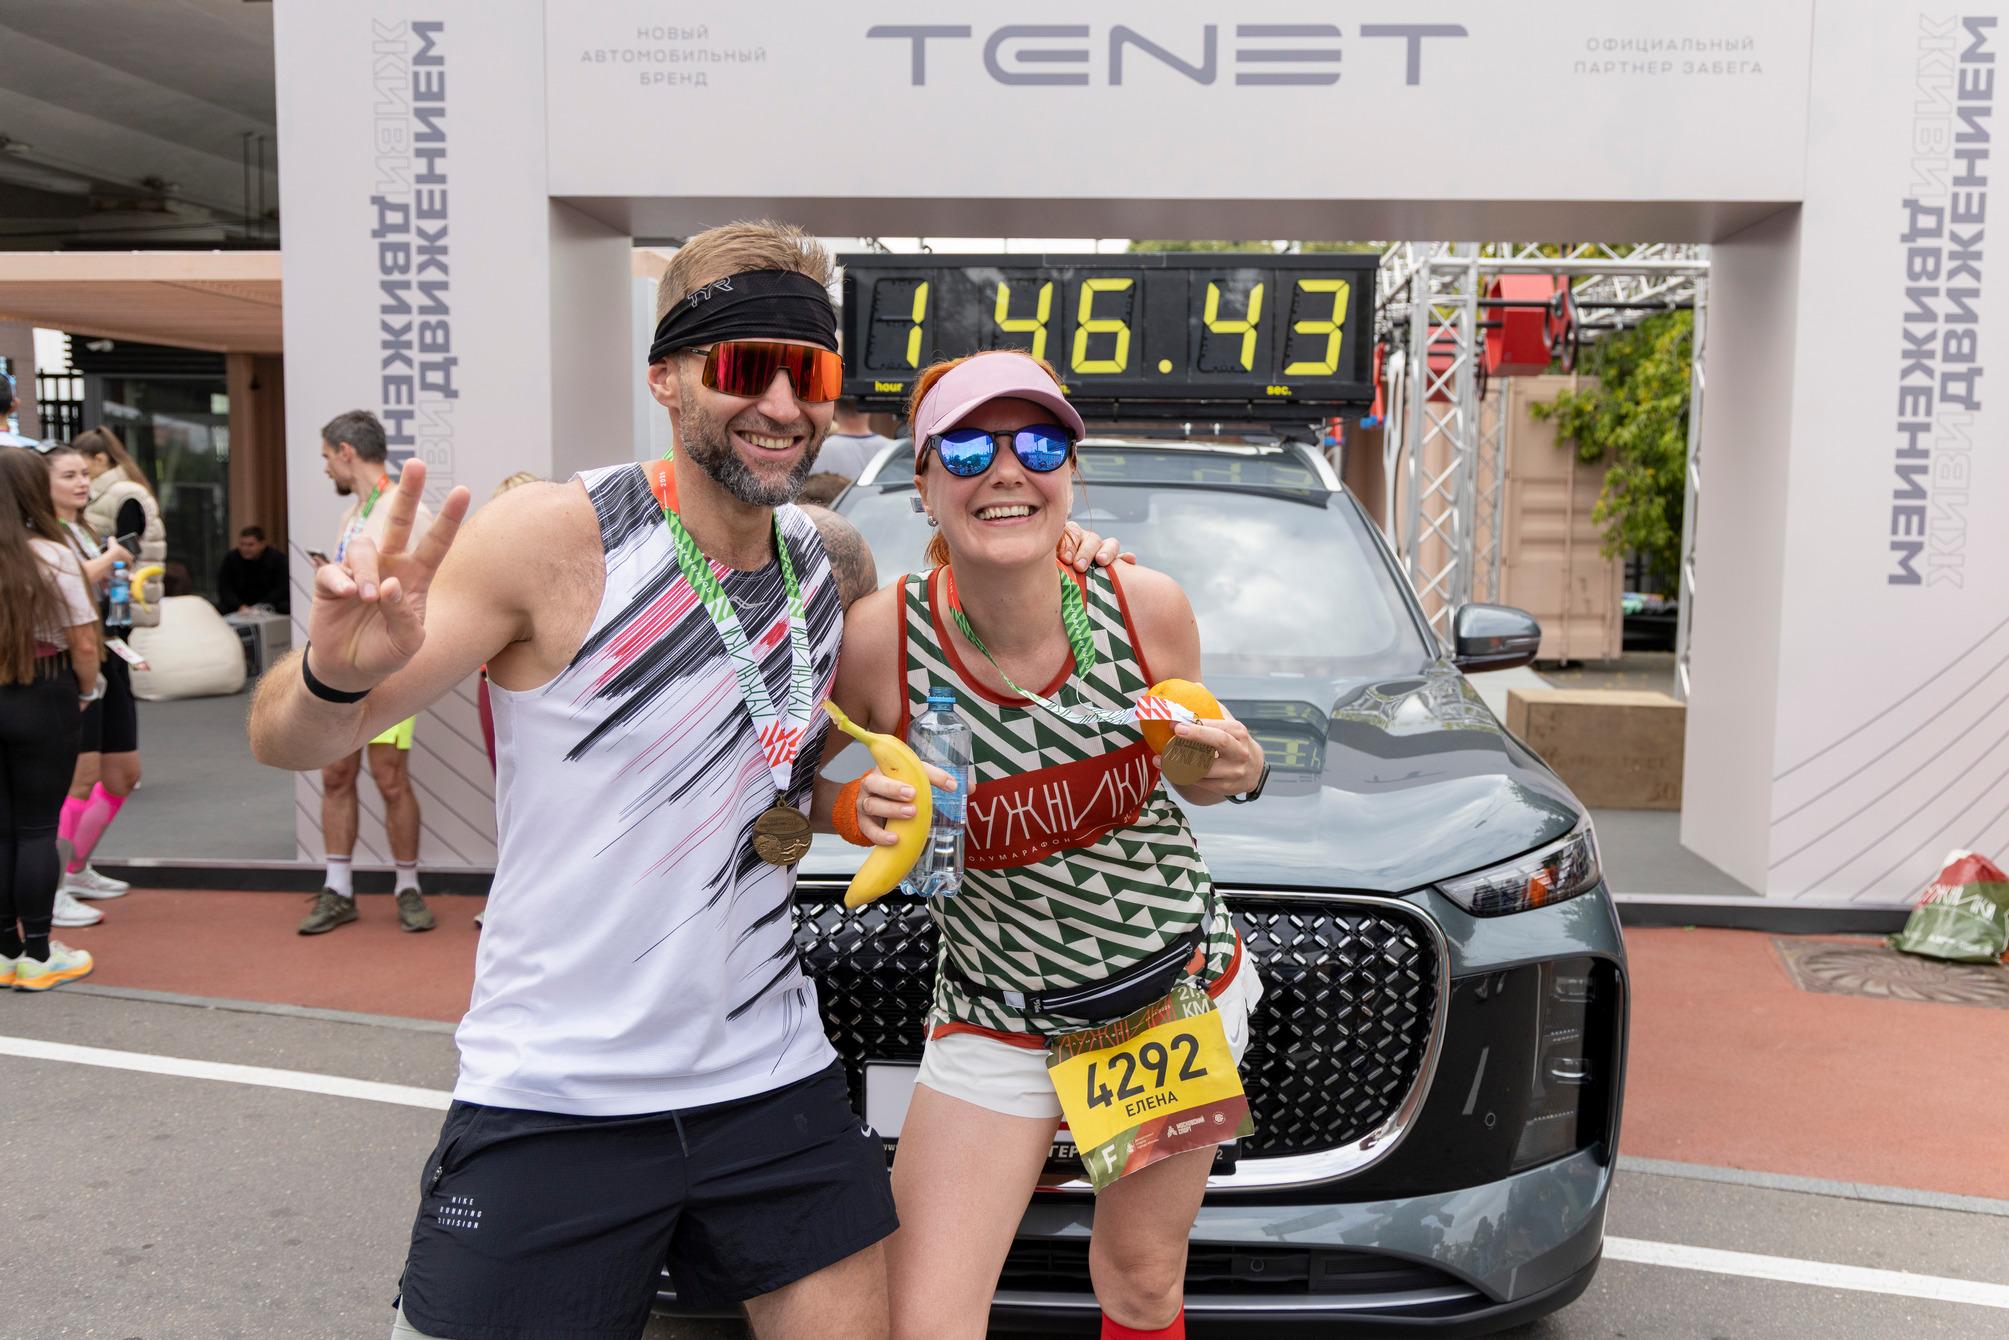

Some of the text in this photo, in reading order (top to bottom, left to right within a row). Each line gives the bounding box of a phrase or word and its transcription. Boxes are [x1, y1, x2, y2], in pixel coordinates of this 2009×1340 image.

[637, 24, 710, 40] НОВЫЙ
[1586, 36, 1755, 52] ОФИЦИАЛЬНЫЙ
[580, 47, 767, 63] АВТОМОБИЛЬНЫЙ
[866, 24, 1468, 86] TENET
[1574, 60, 1763, 74] ПАРТНЕР ЗАБЕГА
[640, 71, 709, 87] БРЕНД
[411, 21, 459, 399] ДВИЖЕНИЕМ
[1939, 16, 1998, 411] ДВИЖЕНИЕМ
[687, 276, 733, 308] TYR
[370, 195, 415, 485] ДВИЖЕНИ
[875, 381, 903, 392] hour
[1266, 385, 1293, 396] sec.
[1888, 198, 1945, 586] ДВИЖЕНИЕМ
[967, 838, 1071, 862] ОЛУМАРАФОН
[1086, 1032, 1208, 1110] 4292
[1125, 1090, 1178, 1118] ЕЛЕНА
[1101, 1144, 1118, 1174] F
[440, 1206, 482, 1218] RUNNING
[452, 1196, 474, 1206] NIKE
